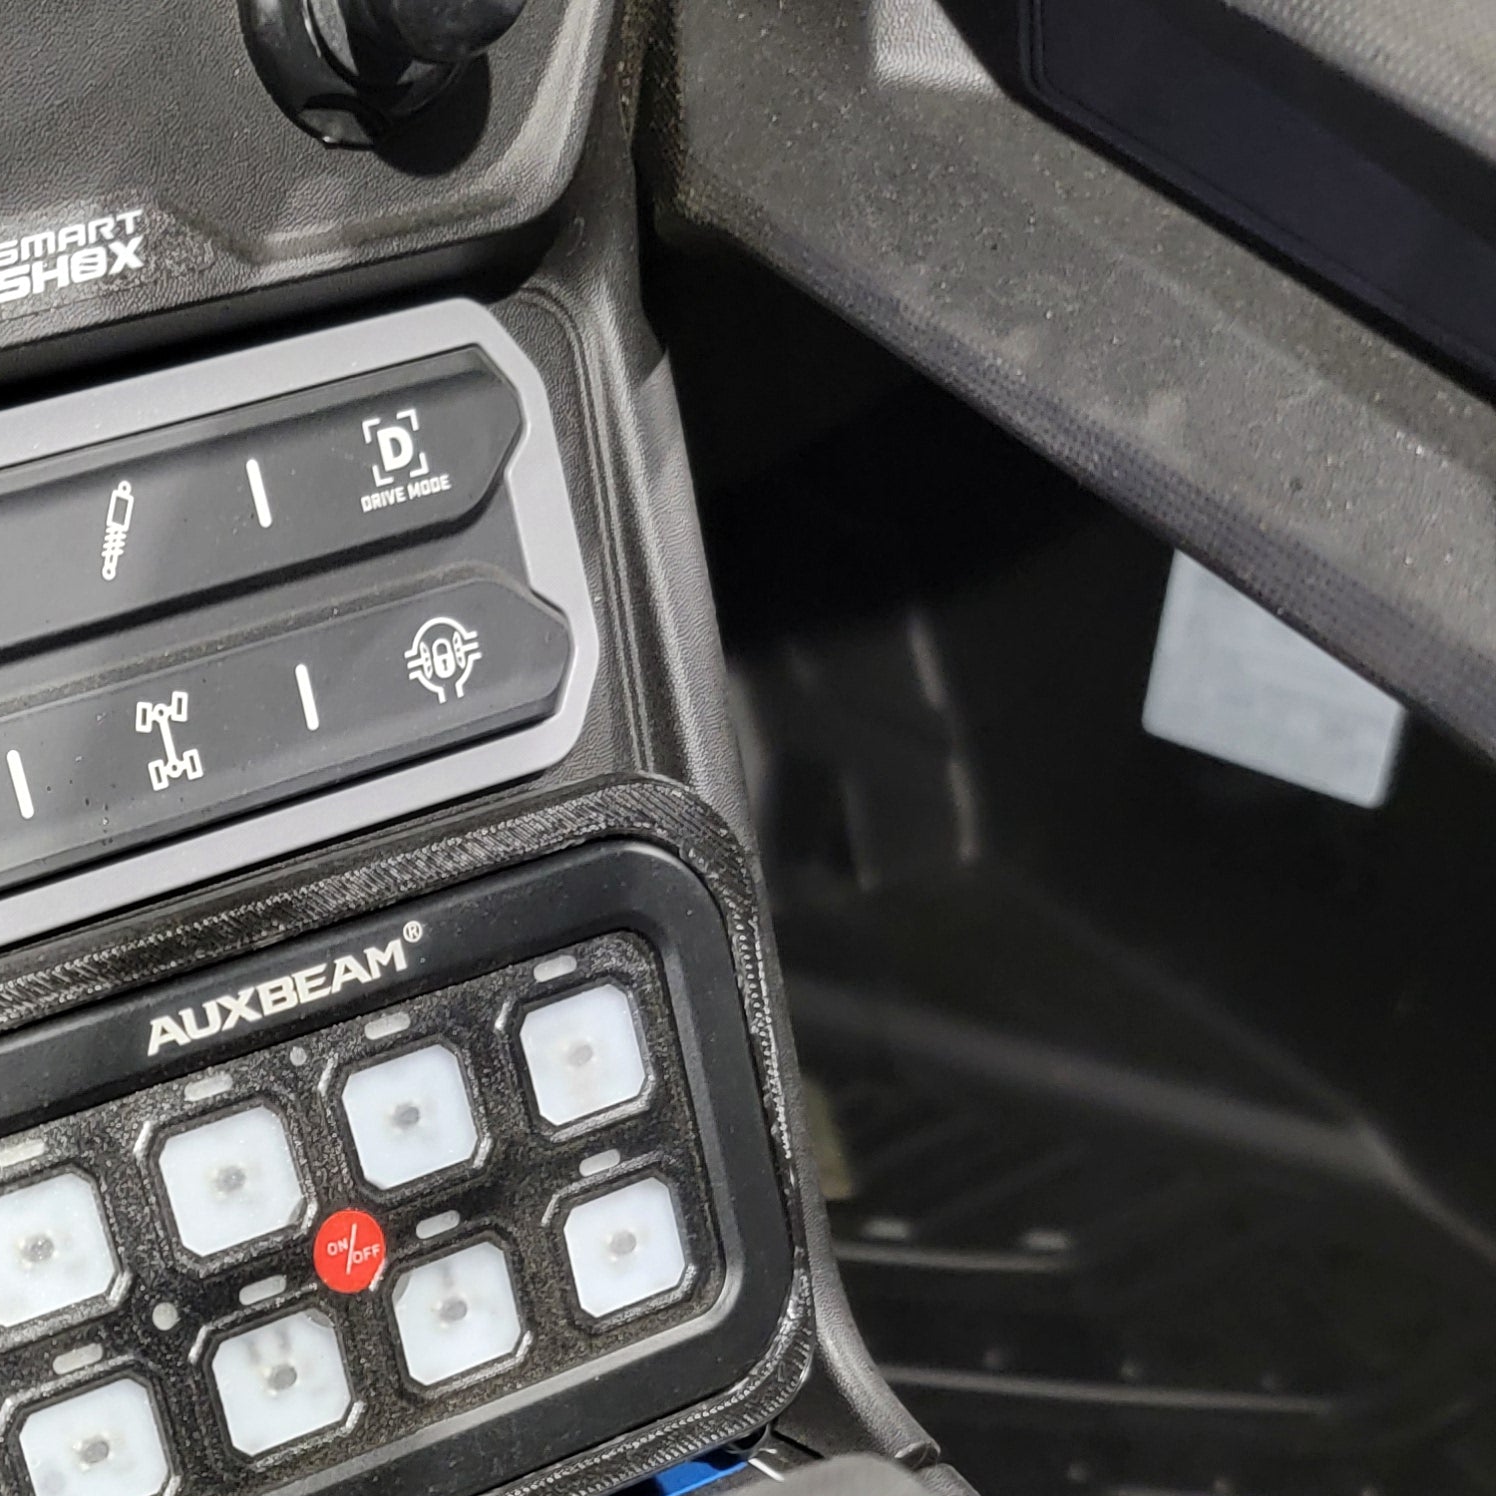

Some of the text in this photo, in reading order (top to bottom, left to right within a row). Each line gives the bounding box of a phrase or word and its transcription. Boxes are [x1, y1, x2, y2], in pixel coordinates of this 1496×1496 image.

[377, 426, 414, 472] D
[360, 473, 452, 513] DRIVE MODE
